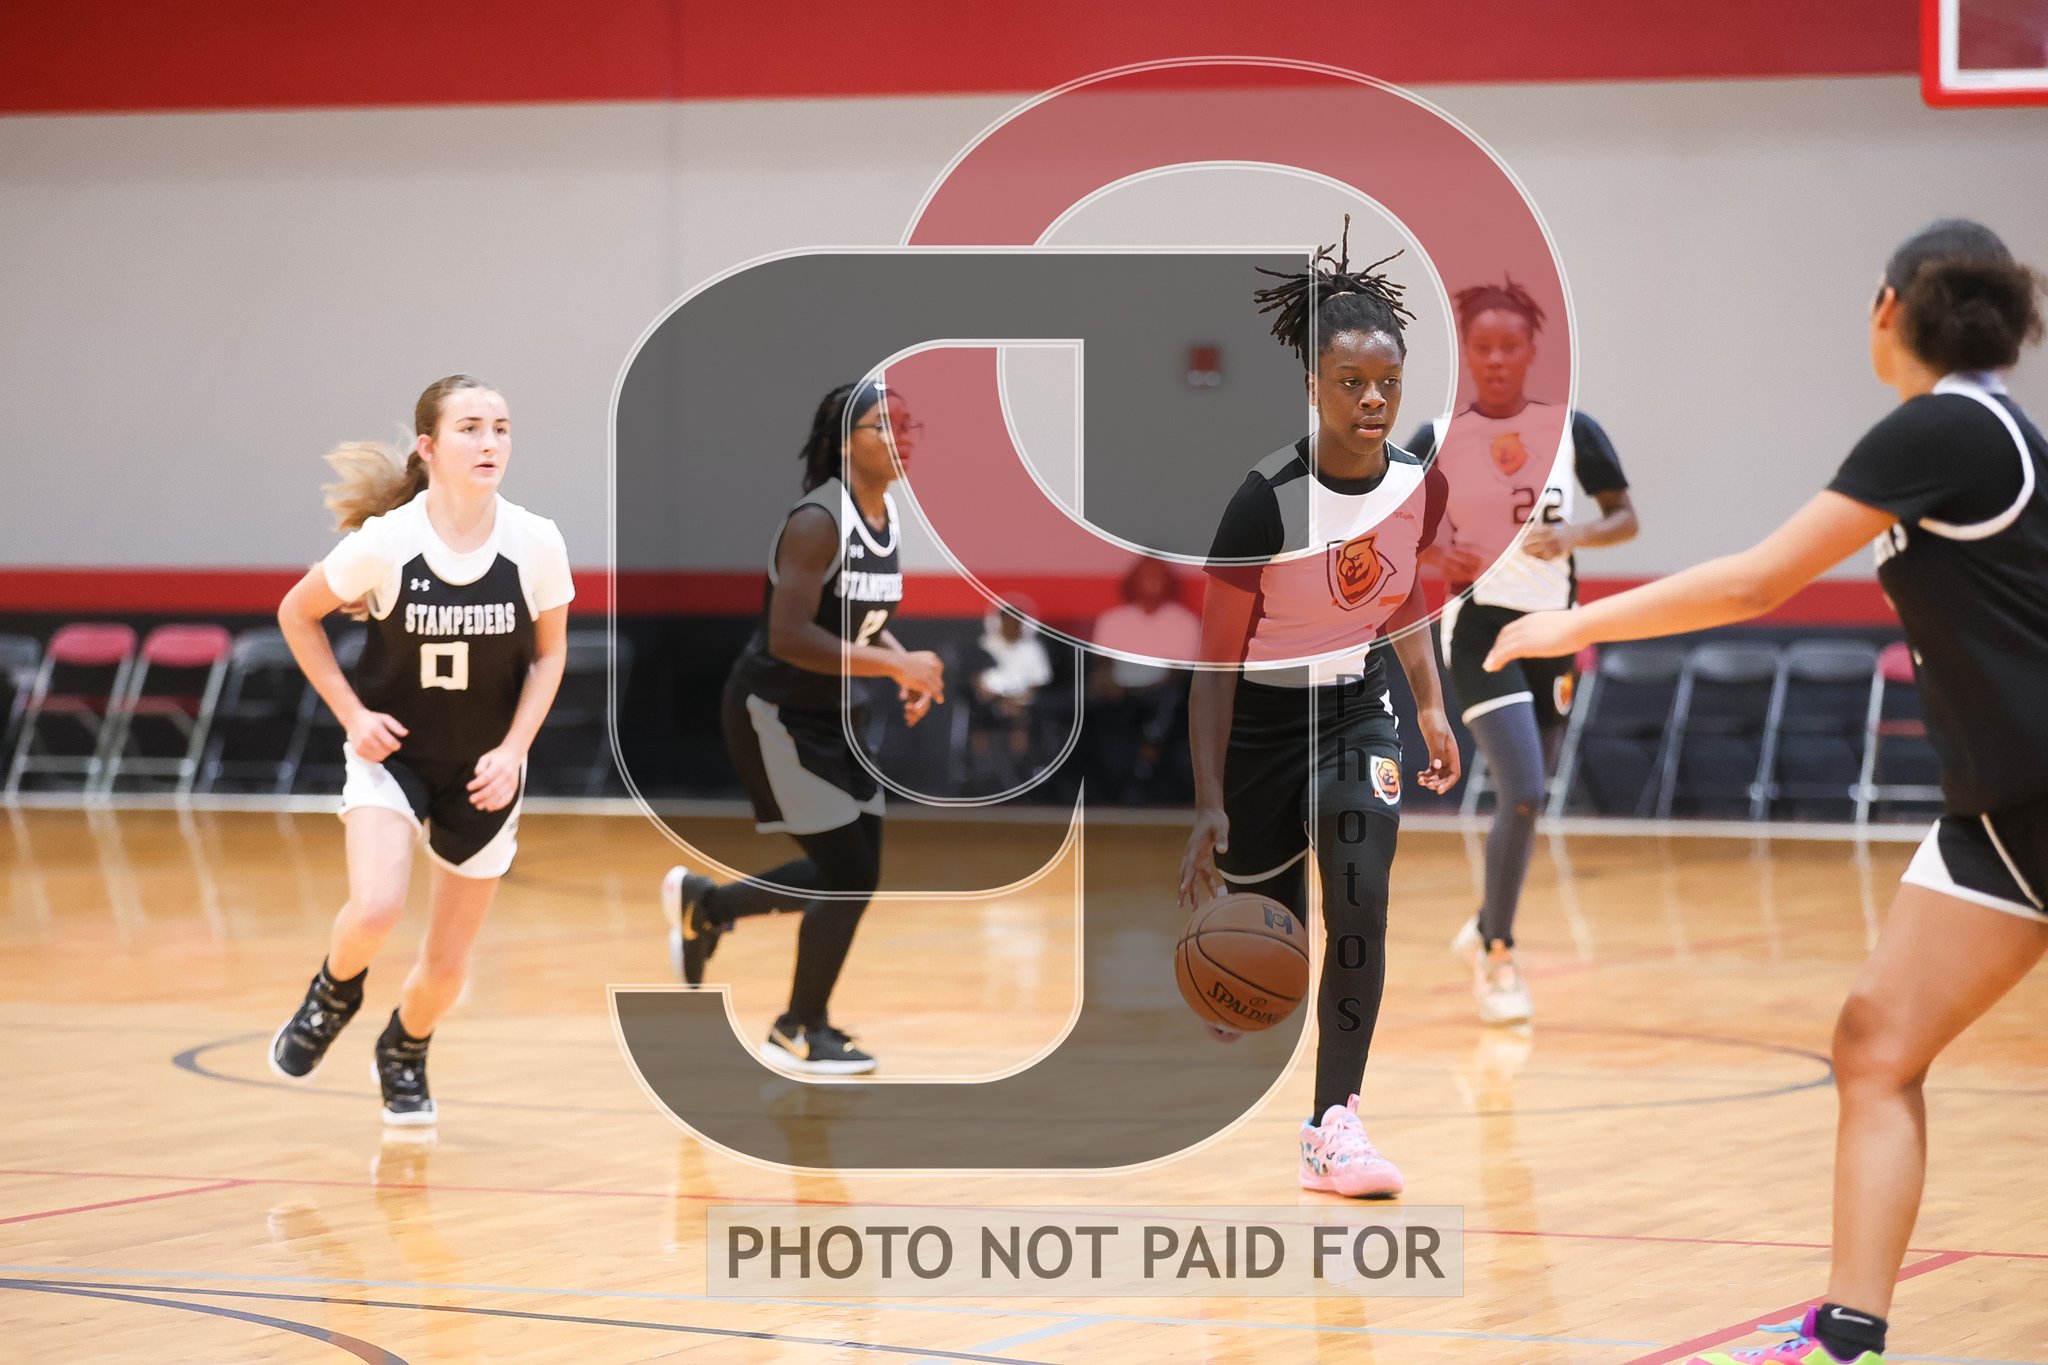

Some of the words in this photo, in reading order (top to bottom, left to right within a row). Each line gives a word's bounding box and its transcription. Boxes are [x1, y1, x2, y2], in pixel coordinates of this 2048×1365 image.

[1511, 487, 1563, 524] 22
[405, 602, 516, 636] STAMPEDERS
[420, 641, 469, 690] 0
